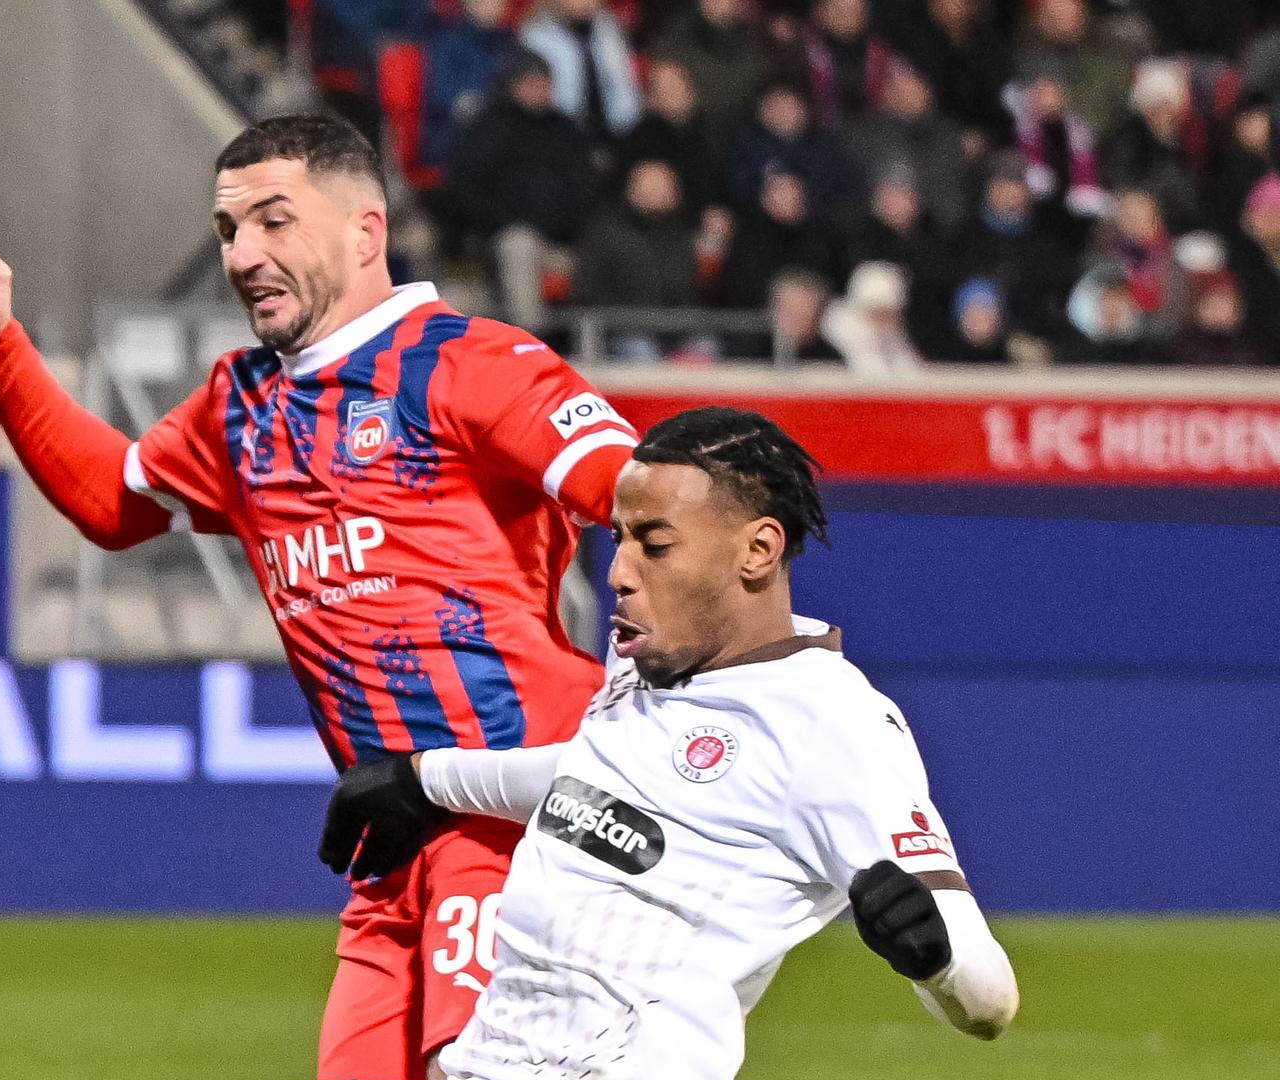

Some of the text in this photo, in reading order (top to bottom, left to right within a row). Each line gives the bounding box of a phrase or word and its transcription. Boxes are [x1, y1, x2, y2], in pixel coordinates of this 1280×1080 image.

[353, 426, 383, 450] FCH
[284, 516, 386, 588] MHP
[320, 574, 398, 606] COMPANY
[545, 791, 648, 854] congstar
